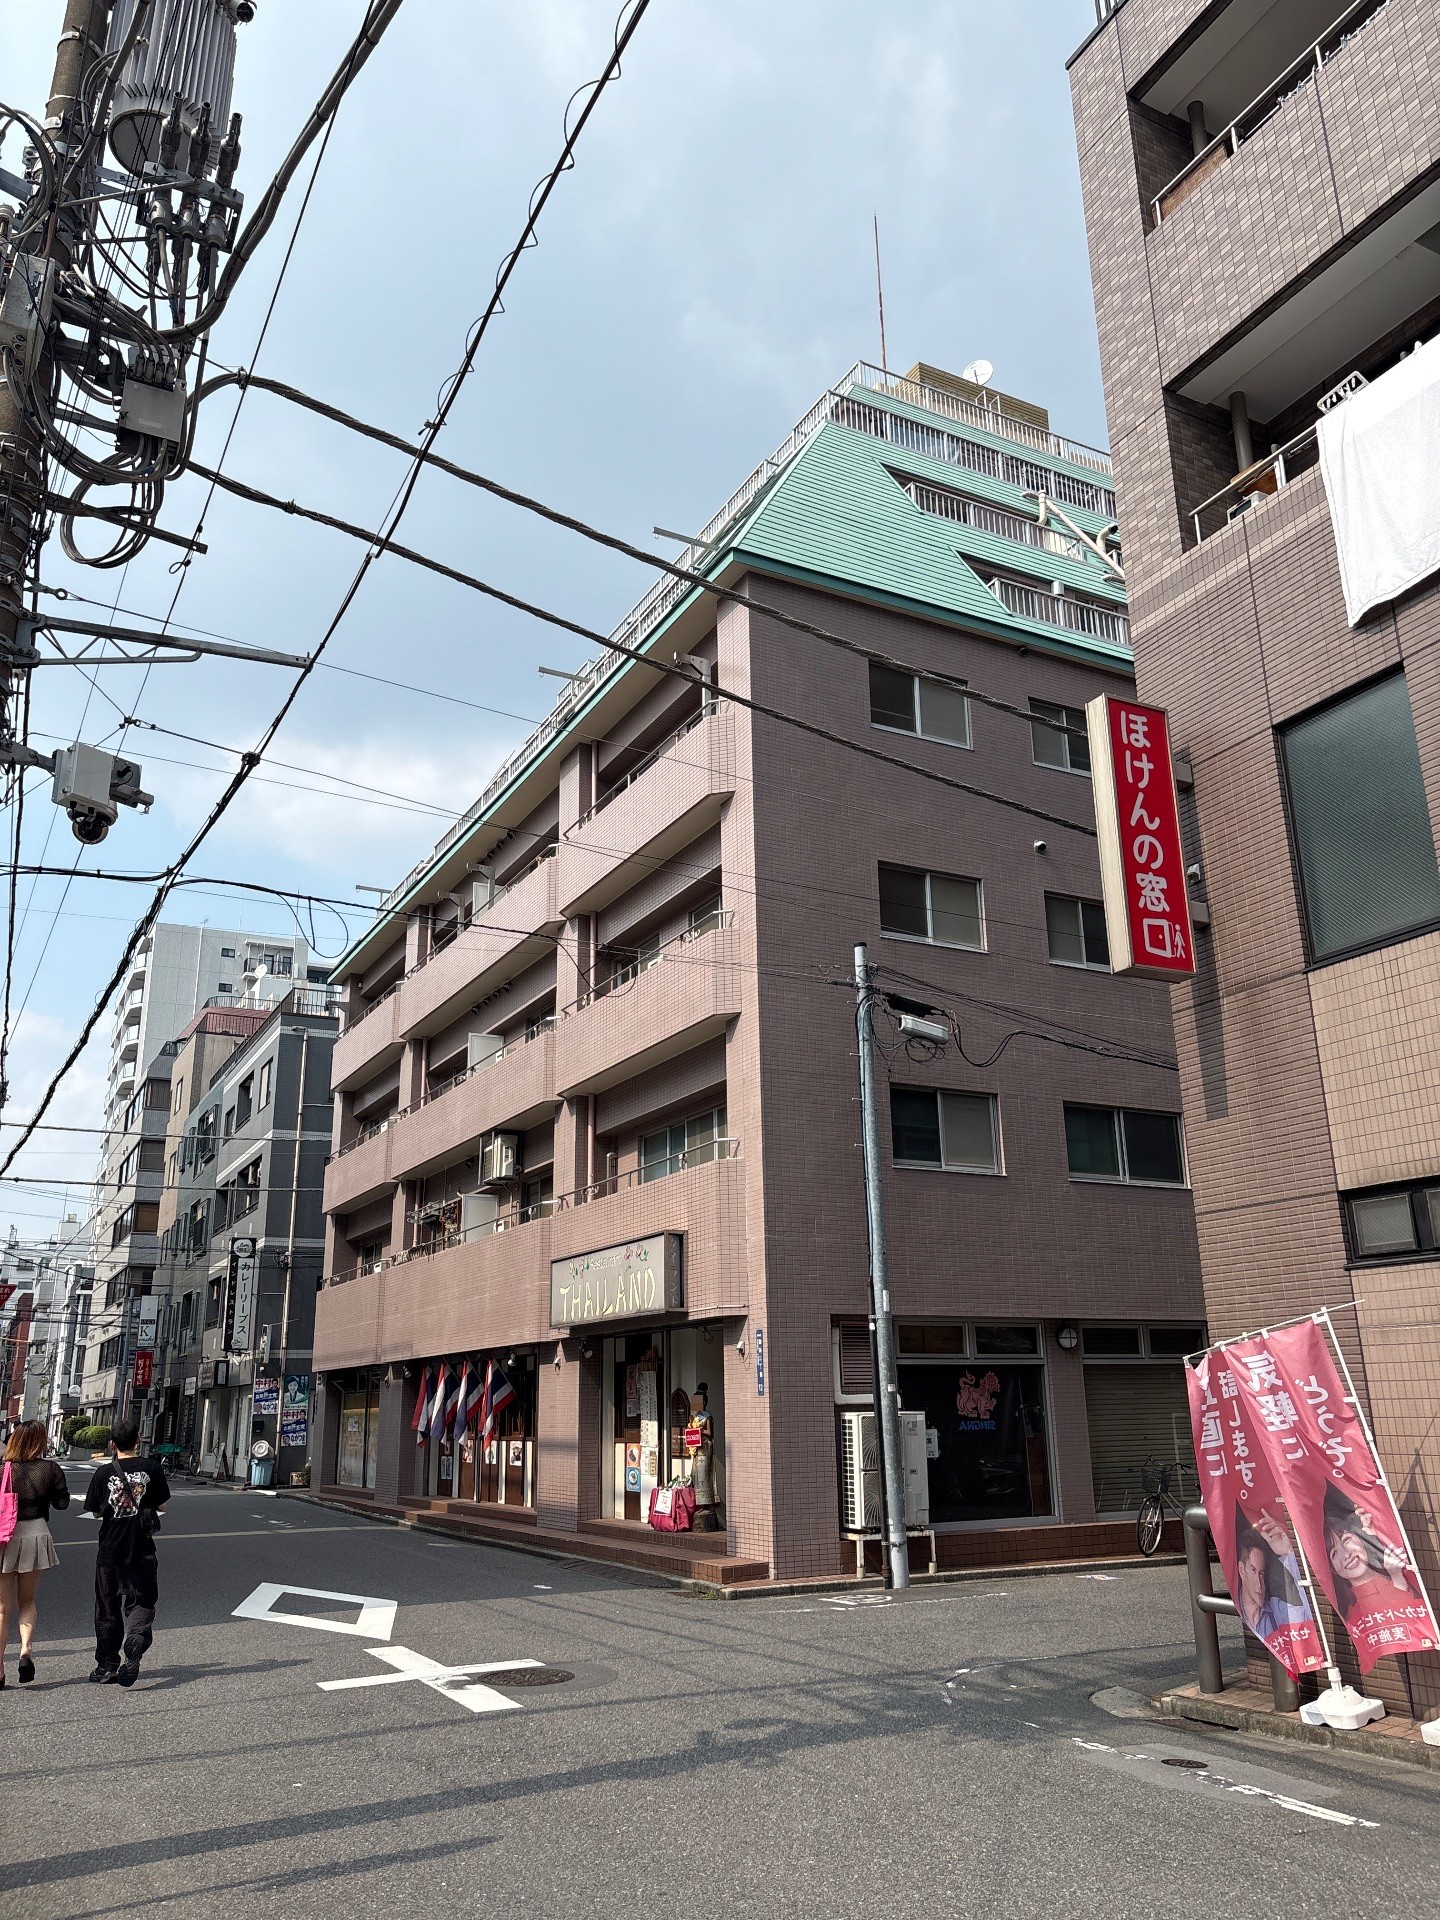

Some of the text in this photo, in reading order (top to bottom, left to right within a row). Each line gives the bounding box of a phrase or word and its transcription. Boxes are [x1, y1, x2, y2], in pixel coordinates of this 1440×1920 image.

[1120, 709, 1172, 959] ほけんの窓口
[227, 1261, 237, 1335] インドレストラン
[236, 1262, 251, 1335] カレーリーブス
[559, 1267, 656, 1322] THAILAND
[590, 1253, 622, 1271] Restaurant
